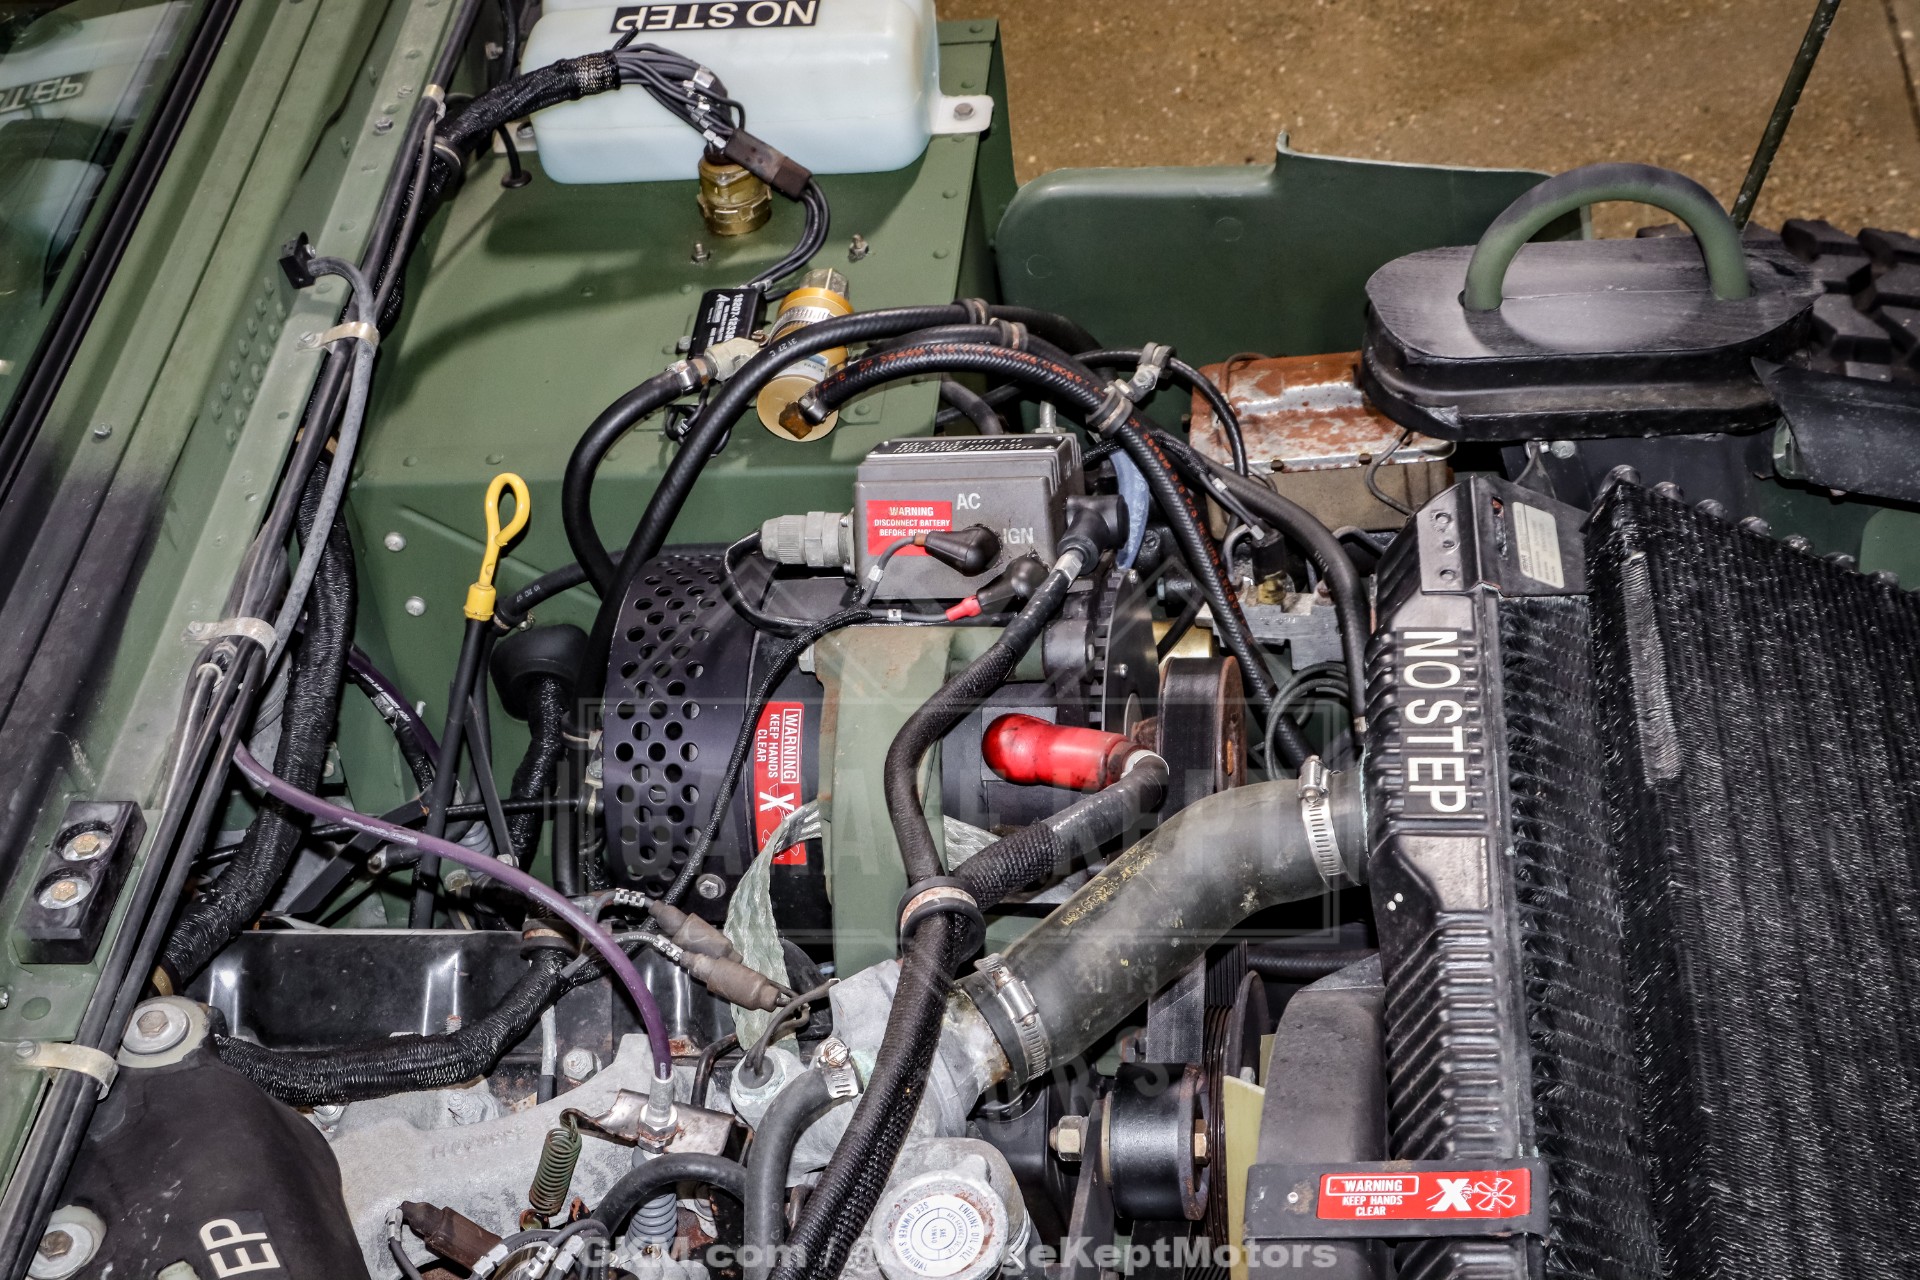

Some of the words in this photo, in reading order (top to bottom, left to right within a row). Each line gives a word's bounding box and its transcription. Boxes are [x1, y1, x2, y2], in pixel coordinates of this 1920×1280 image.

[616, 3, 739, 31] STEP
[747, 1, 816, 26] NO
[956, 492, 982, 511] AC
[889, 506, 934, 517] WARNING
[874, 519, 919, 528] DISCONNECT
[920, 519, 951, 527] BATTERY
[879, 528, 907, 537] BEFORE
[908, 529, 946, 537] REMO
[1002, 527, 1035, 545] IGN
[1403, 631, 1461, 689] NO
[769, 713, 781, 739] KEEP
[756, 729, 768, 762] CLEAR
[783, 713, 799, 779] WARNING
[768, 742, 779, 778] HANDS
[1405, 699, 1466, 812] STEP
[1344, 1179, 1403, 1192] WARNING
[914, 1201, 929, 1215] SEE
[1342, 1196, 1366, 1206] KEEP
[1370, 1196, 1403, 1205] HANDS
[958, 1203, 980, 1228] ENGINE
[1355, 1206, 1386, 1217] CLEAR
[970, 1232, 980, 1244] OIL
[901, 1247, 928, 1272] MANUAL
[959, 1245, 977, 1261] FILL
